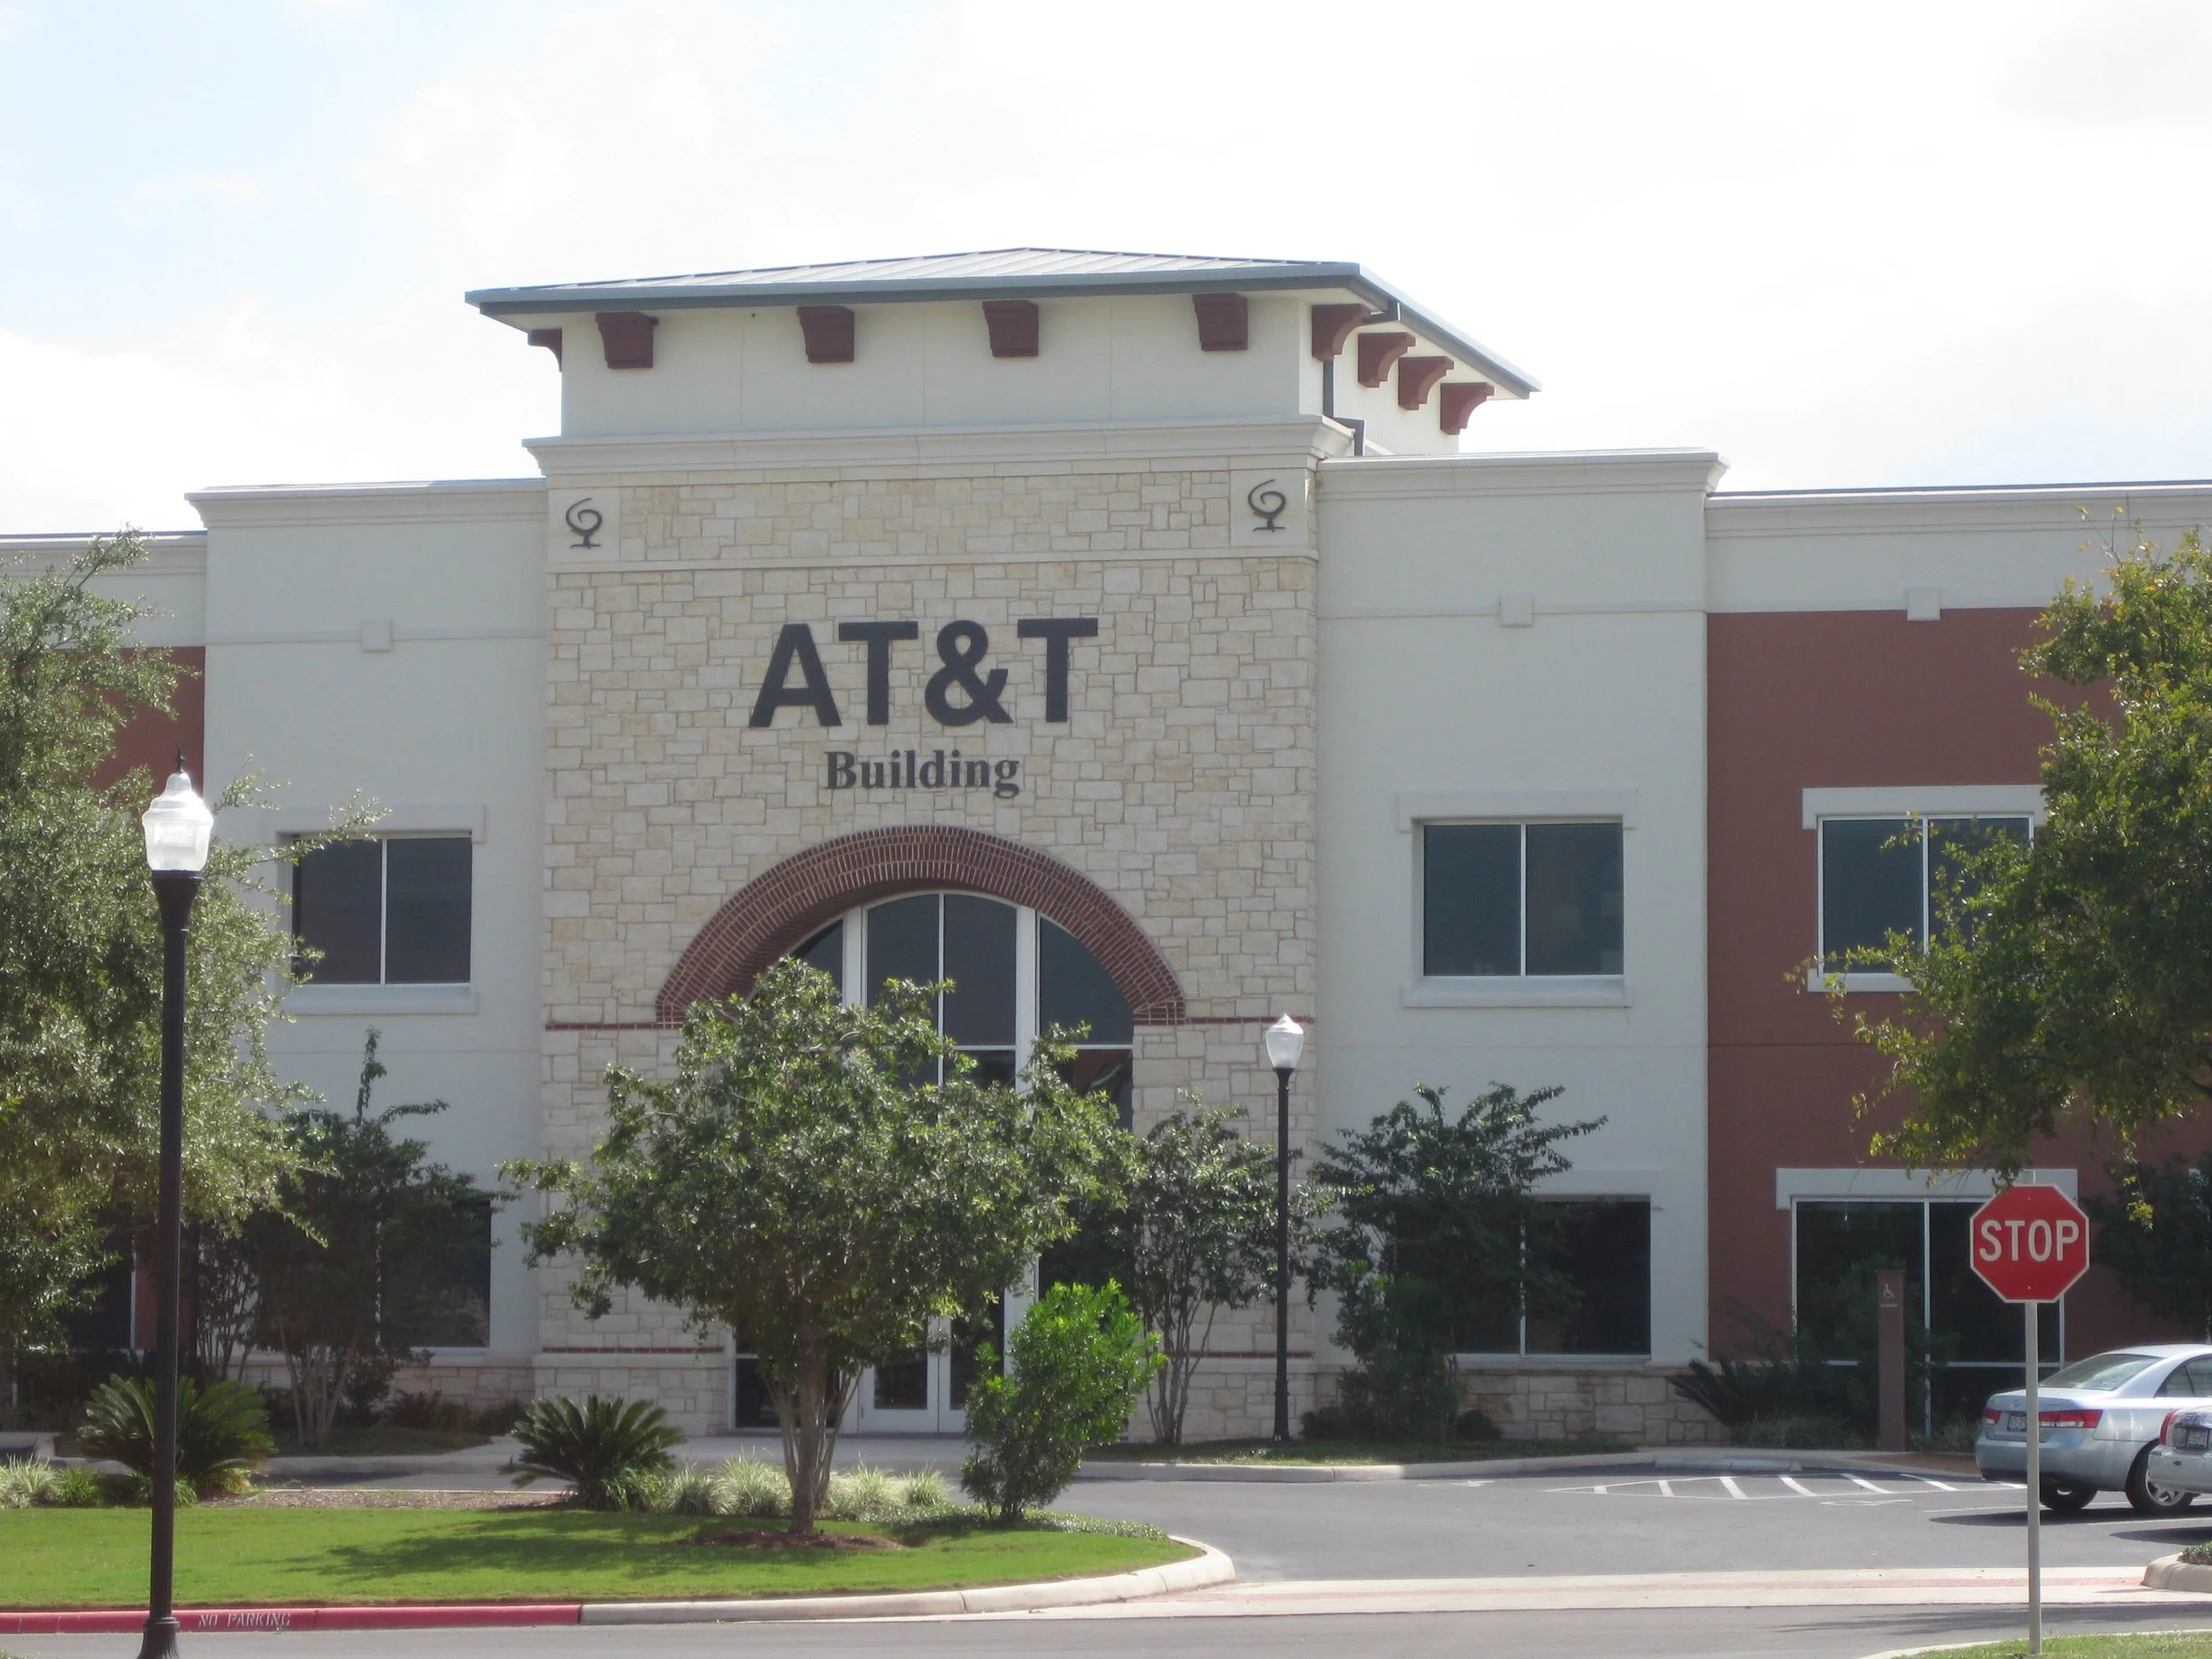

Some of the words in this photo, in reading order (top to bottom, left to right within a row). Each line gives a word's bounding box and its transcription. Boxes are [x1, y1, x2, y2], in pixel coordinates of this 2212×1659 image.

[748, 618, 1099, 728] AT&T
[824, 749, 1020, 798] Building
[1978, 1219, 2079, 1262] STOP
[198, 1614, 219, 1627] NO
[227, 1612, 291, 1627] PARKING
